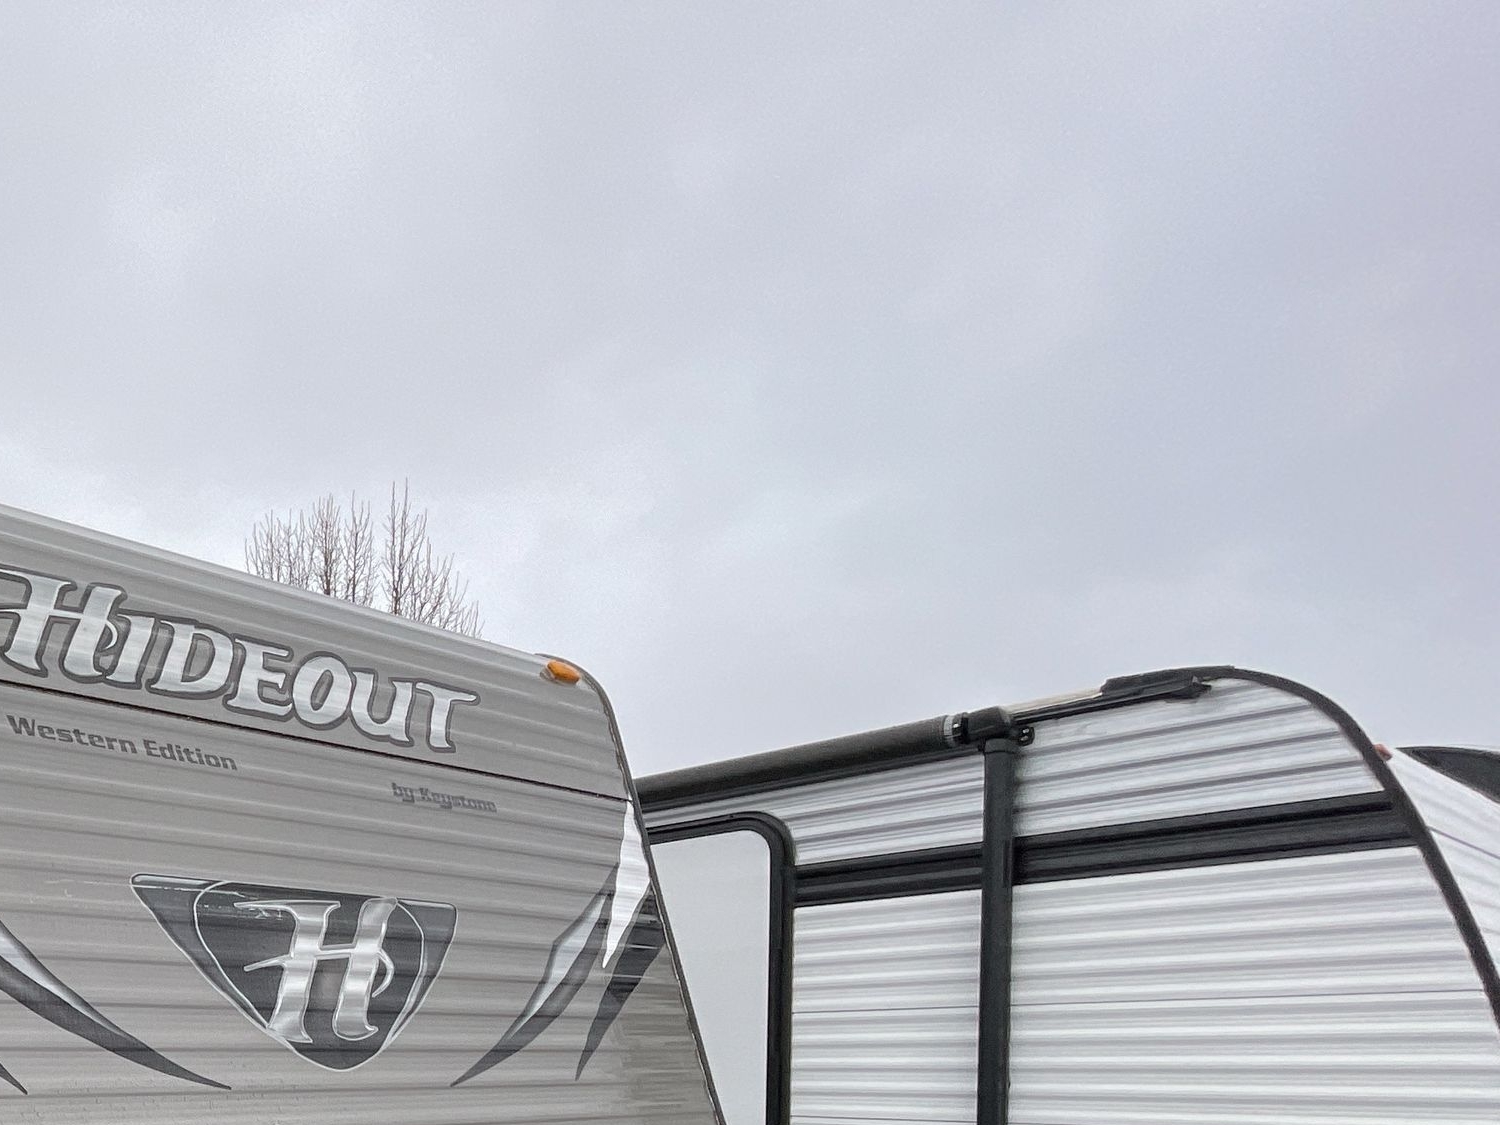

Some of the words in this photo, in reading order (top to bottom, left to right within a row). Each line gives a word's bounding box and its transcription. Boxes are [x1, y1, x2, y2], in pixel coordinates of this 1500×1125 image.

[6, 714, 138, 754] Western
[143, 738, 239, 771] Edition
[392, 782, 415, 803] by
[234, 898, 399, 1043] H
